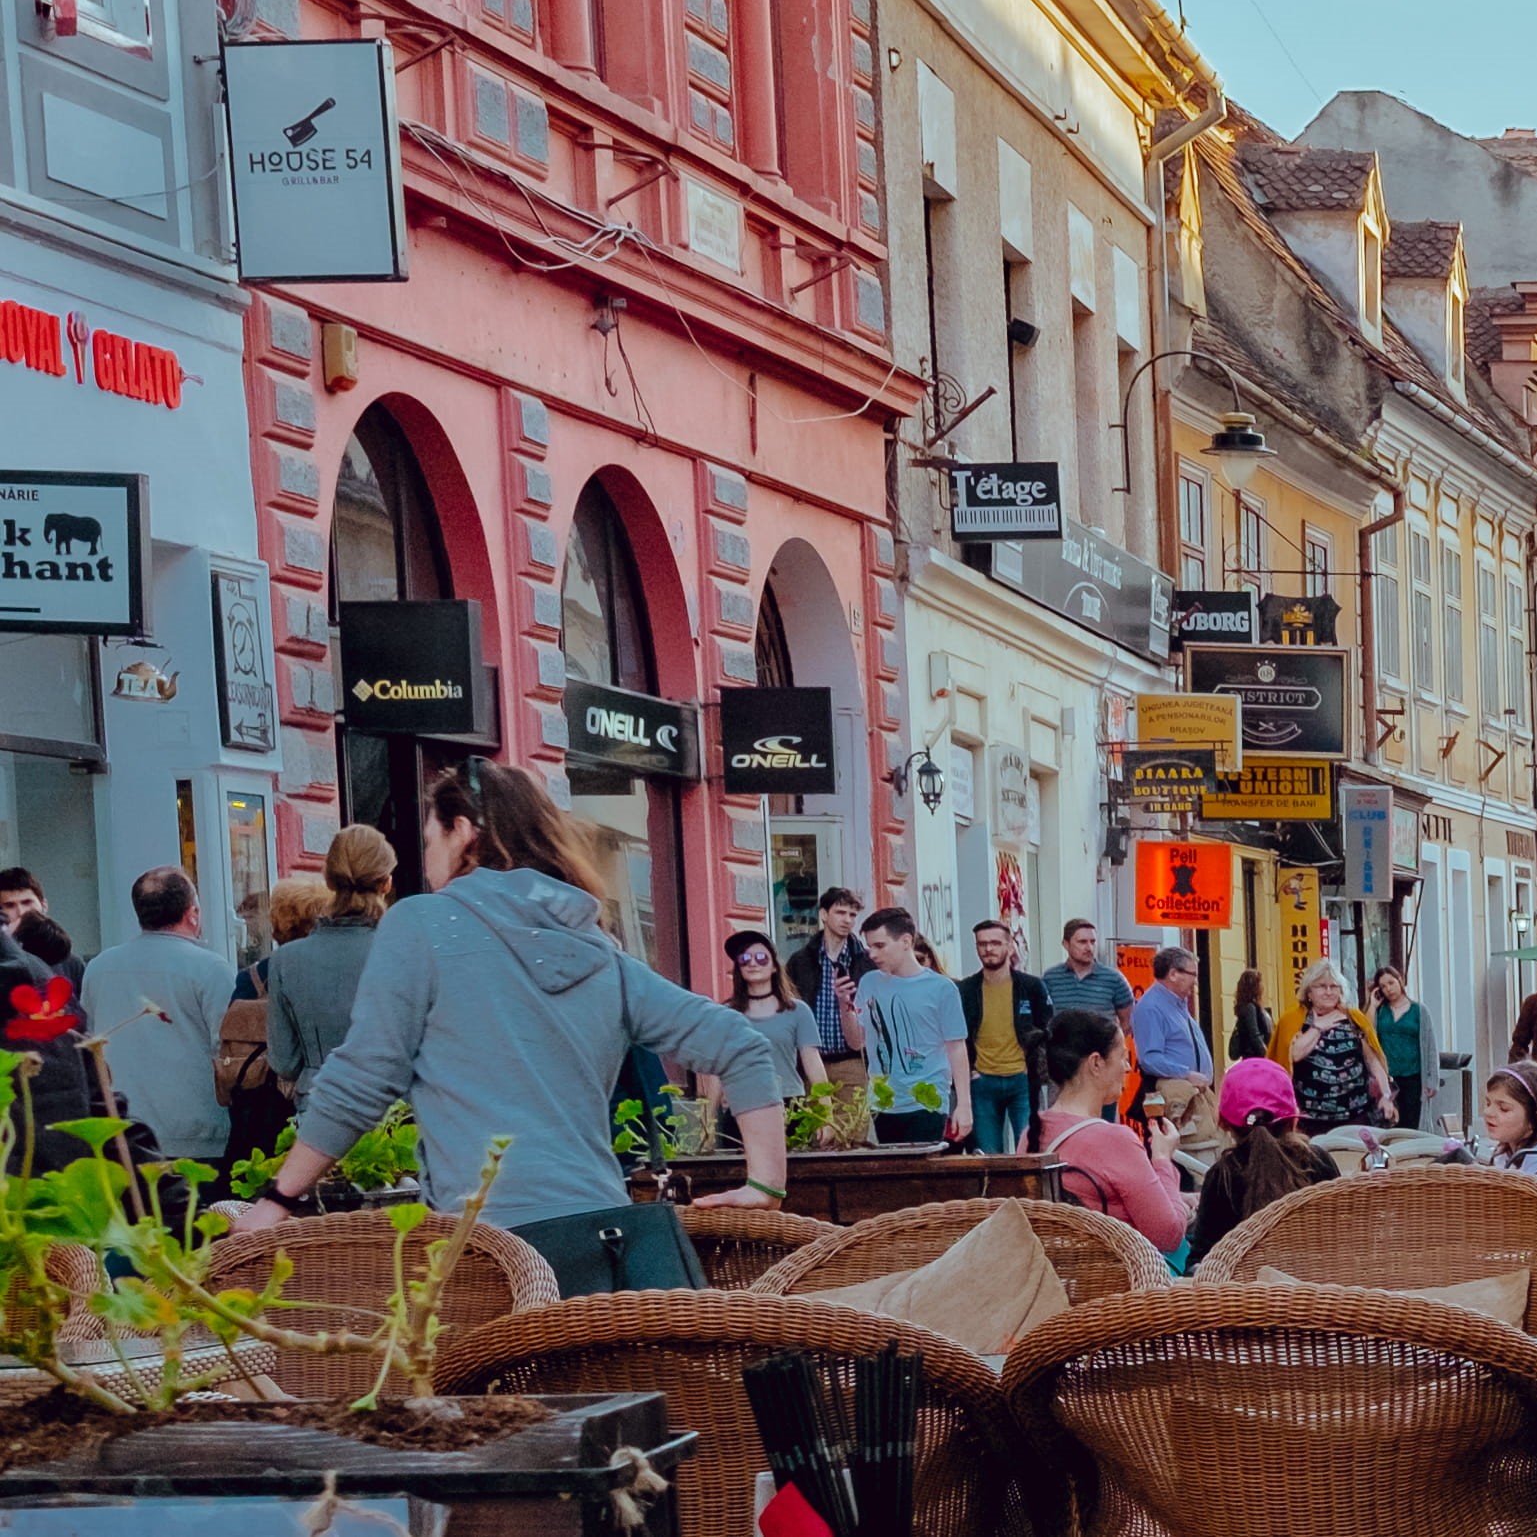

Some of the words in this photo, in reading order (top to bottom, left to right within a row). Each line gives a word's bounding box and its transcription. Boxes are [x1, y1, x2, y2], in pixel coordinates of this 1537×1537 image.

[249, 148, 337, 173] HOUSE
[345, 148, 372, 170] 54
[0, 299, 66, 377] OYAL
[92, 329, 182, 410] GELATO
[119, 672, 163, 699] TEA
[373, 679, 463, 701] Columbia
[1230, 689, 1307, 704] ISTRICT
[586, 706, 652, 747] O'NEILL
[731, 754, 827, 769] O'NEILL
[1134, 784, 1208, 797] BOUTIQUE
[1240, 781, 1308, 794] UNION
[1276, 799, 1289, 808] DE
[1292, 798, 1317, 808] BANI
[1169, 847, 1198, 863] Pell
[1145, 894, 1221, 913] Collection
